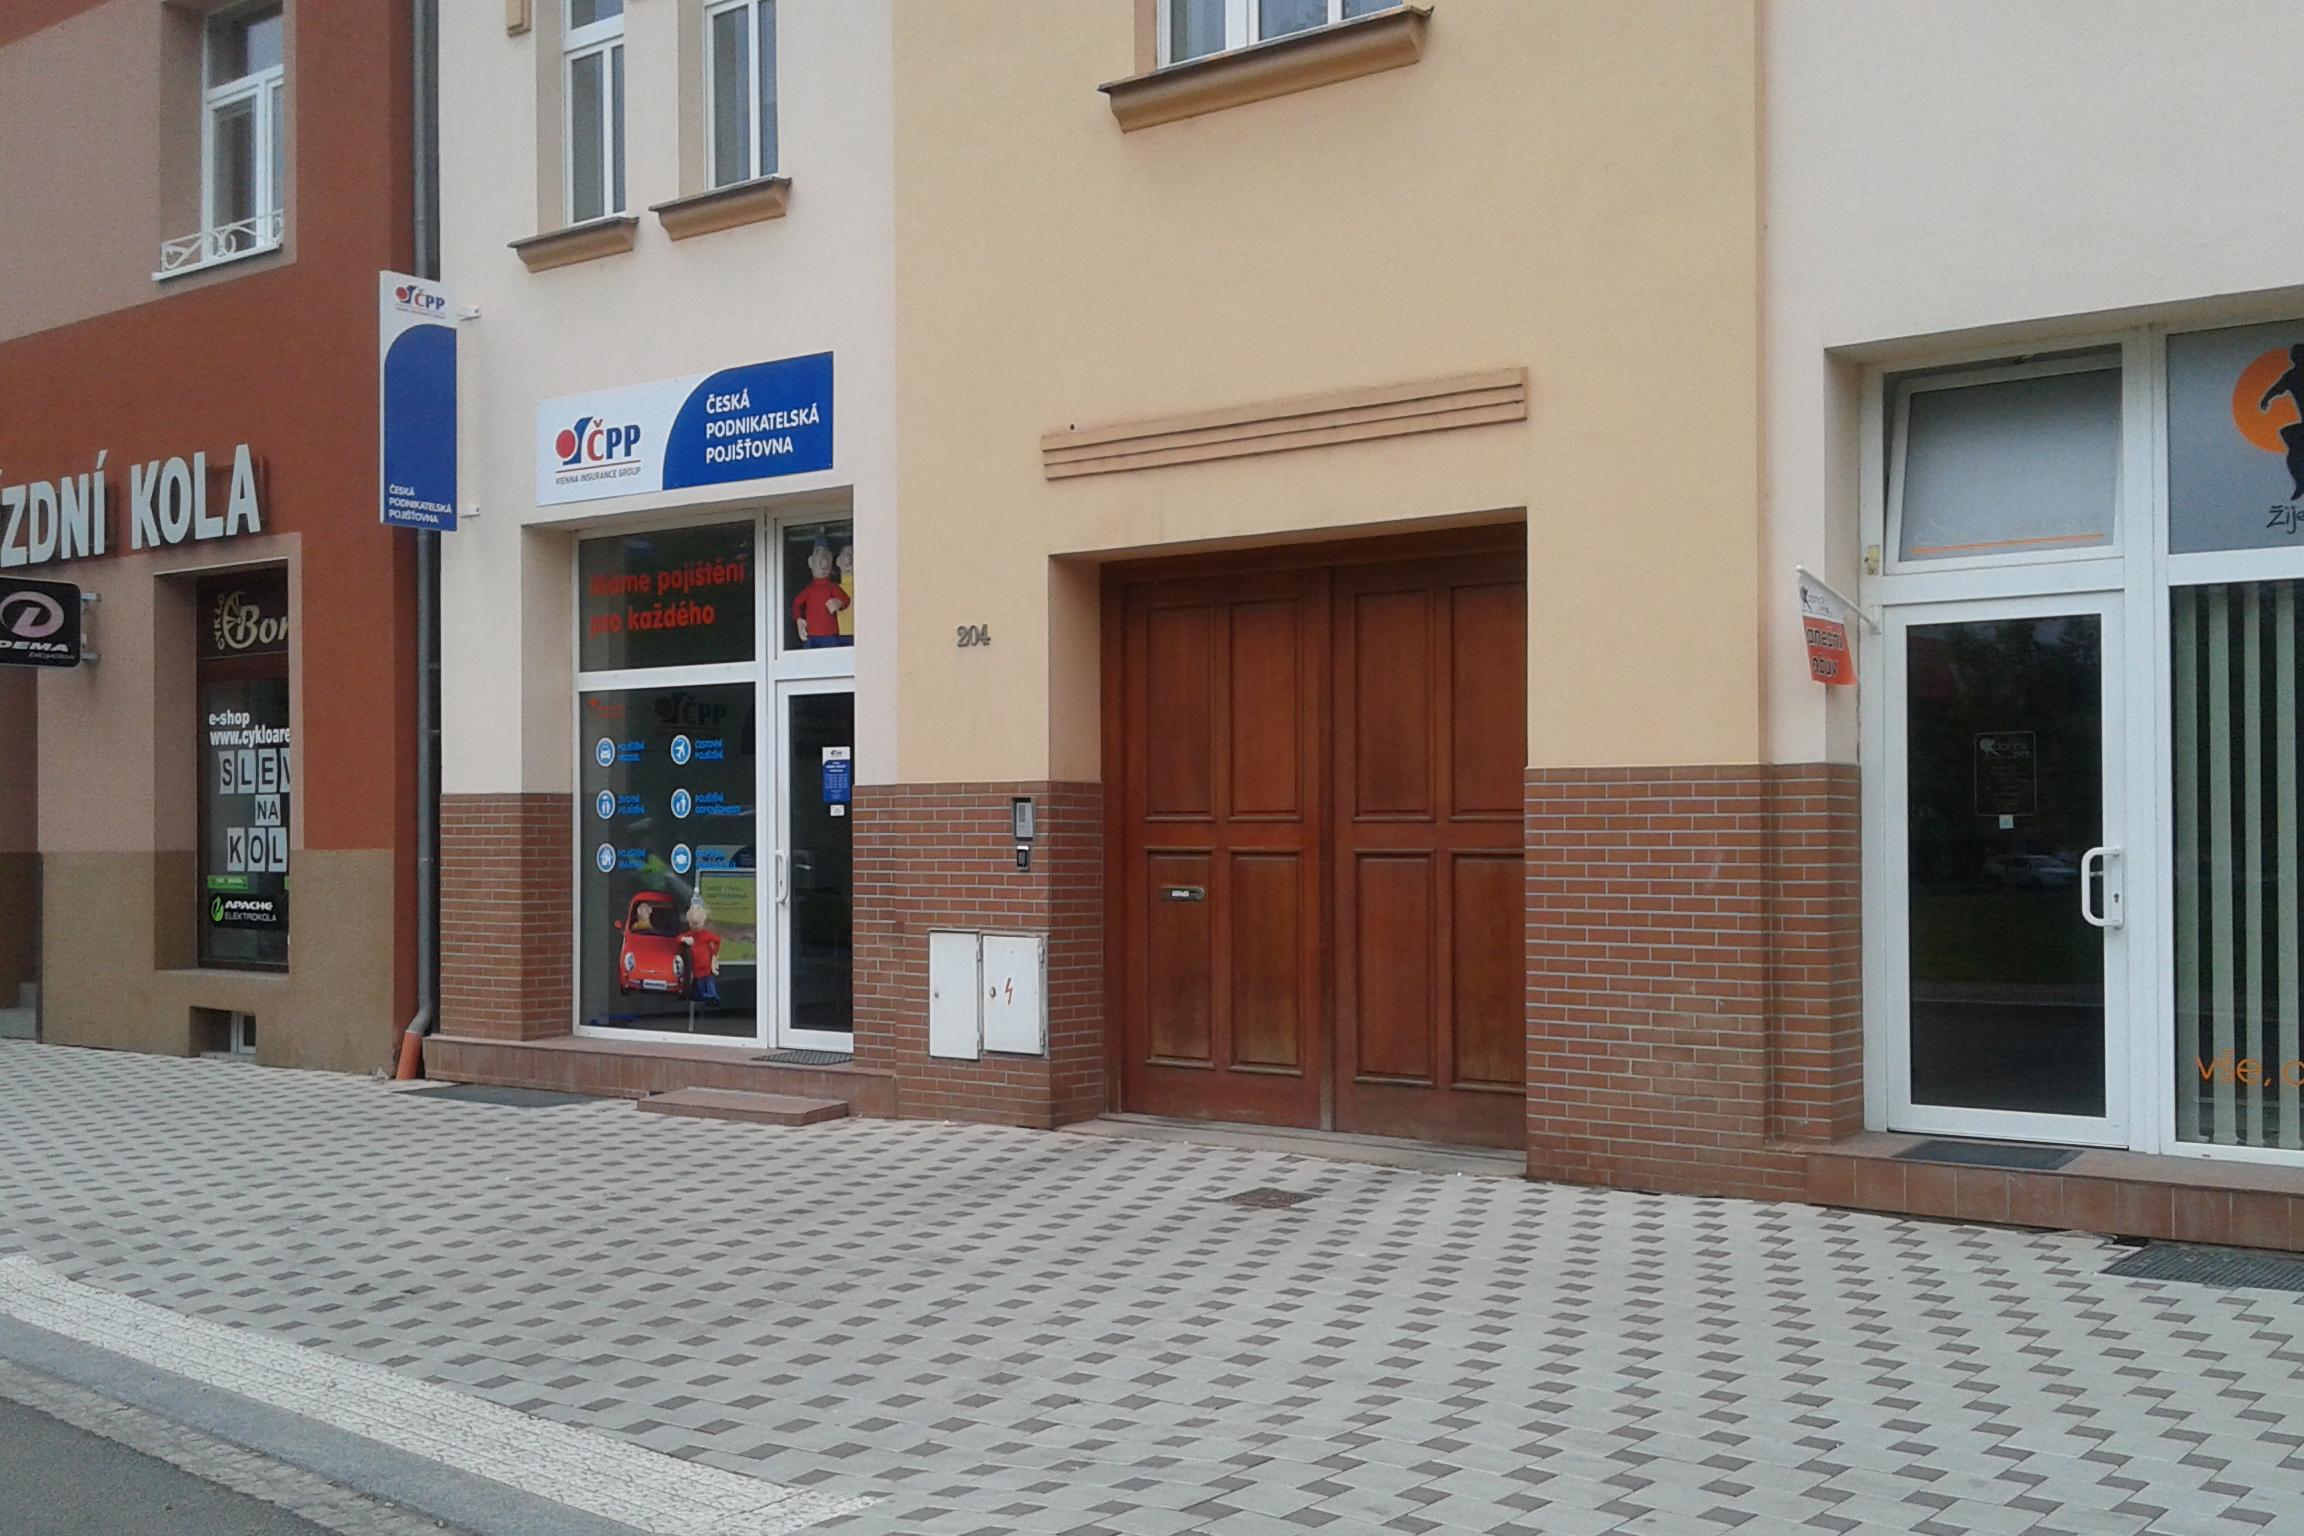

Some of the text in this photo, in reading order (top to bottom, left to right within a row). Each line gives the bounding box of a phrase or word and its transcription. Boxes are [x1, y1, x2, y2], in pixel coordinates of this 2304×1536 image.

[414, 288, 445, 310] ČPP
[705, 388, 750, 414] ČESKÁ
[705, 402, 820, 439] PODNIKATELSKÁ
[587, 419, 641, 461] ČPP
[705, 436, 794, 464] POJIŠŤOVNA
[556, 466, 642, 485] VIENNA INSURANCE GROUP
[388, 483, 415, 497] ČESKÁ
[0, 443, 262, 567] ZDNÍ KOLA
[388, 496, 453, 514] PODNIKATELSKÁ
[388, 509, 439, 524] POJIŠŤOVNA
[657, 555, 747, 595] pojištění
[627, 600, 717, 633] každého
[956, 622, 991, 648] 204
[0, 640, 69, 653] DEMA
[209, 709, 250, 726] e-shop
[257, 801, 279, 820] NA
[229, 835, 284, 865] KOL
[224, 911, 277, 922] ELEKTROKOLA
[225, 900, 274, 911] APACHE
